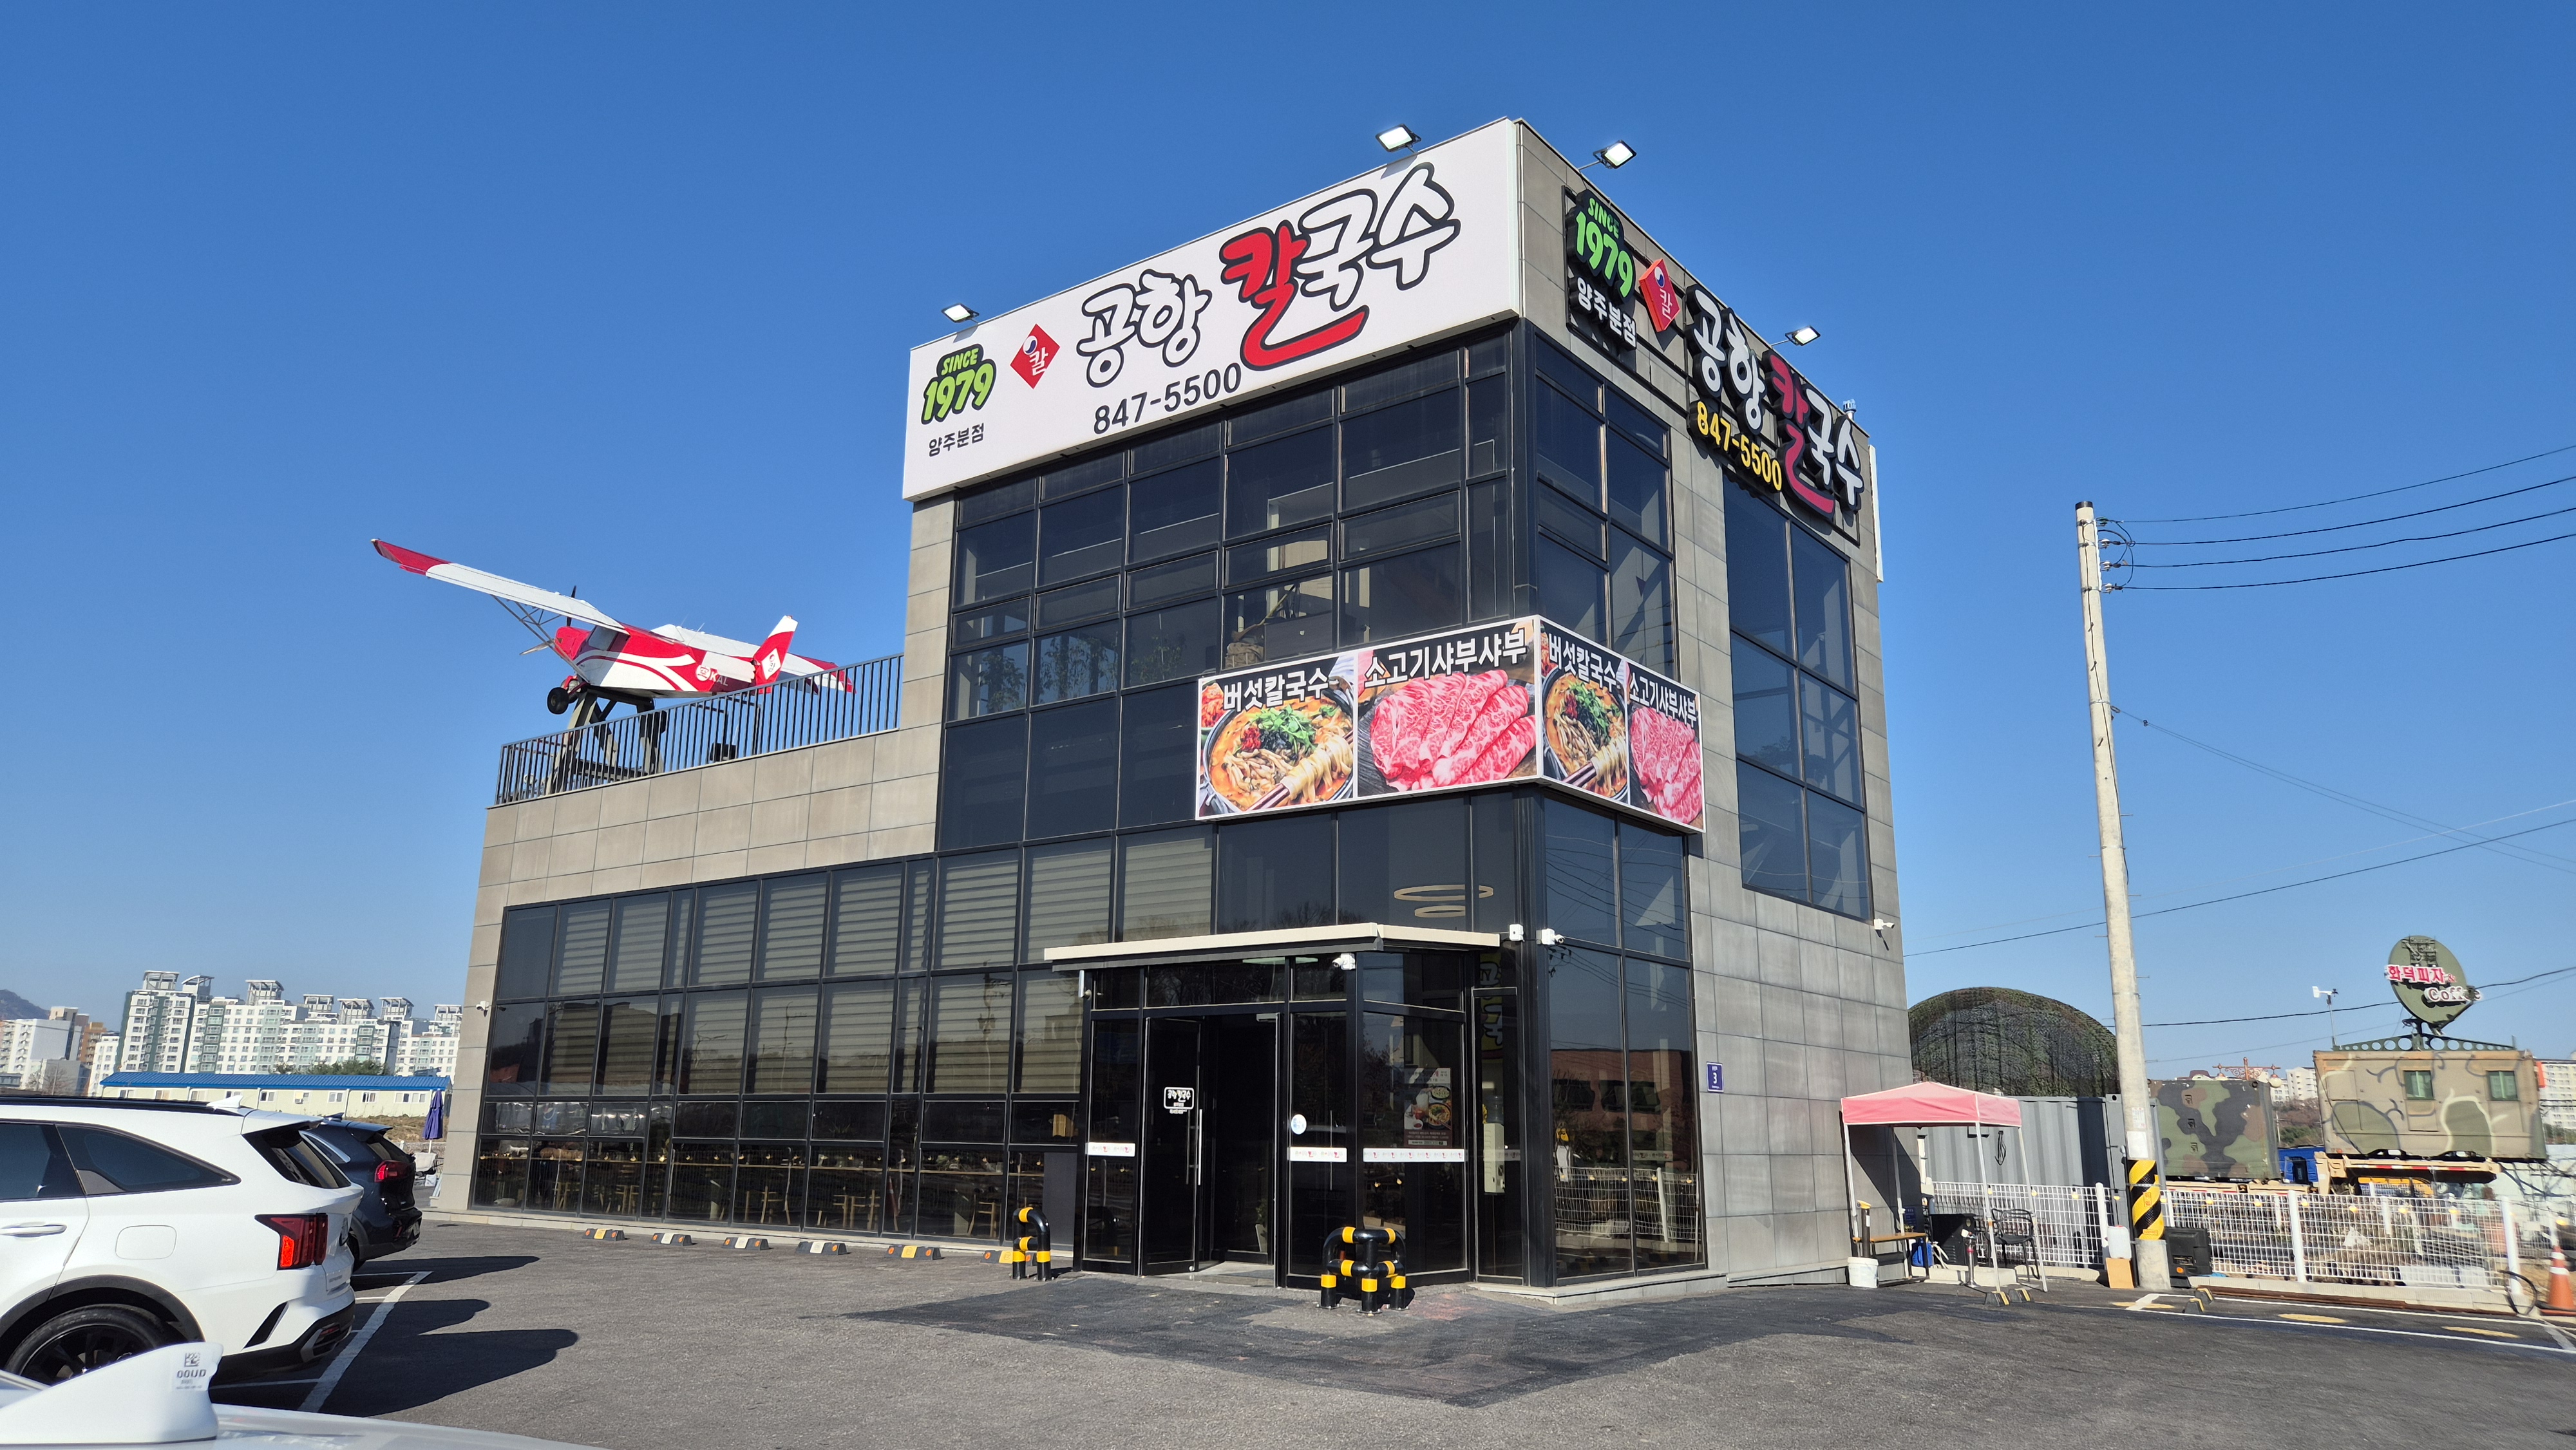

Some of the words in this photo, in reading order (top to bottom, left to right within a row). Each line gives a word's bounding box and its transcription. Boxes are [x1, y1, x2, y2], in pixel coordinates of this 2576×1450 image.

[1588, 198, 1620, 239] SINCE
[1077, 269, 1211, 388] 공항
[1220, 162, 1461, 371] 칼국수
[1576, 211, 1633, 298] 1979
[1577, 277, 1636, 348] 양주분점
[1660, 288, 1673, 320] 칼
[941, 348, 979, 375] SINCE
[1029, 346, 1048, 376] 칼
[923, 362, 994, 422] 1979
[1094, 362, 1242, 434] 847-5500
[1694, 288, 1765, 431] 공항
[1770, 354, 1862, 514] 칼국수
[928, 422, 985, 458] 양주분점
[1697, 401, 1783, 491] 847-5500
[710, 671, 728, 686] KAL
[1365, 626, 1527, 688] 소고기샤부샤부
[1548, 632, 1619, 692] 버섯칼국수
[1223, 673, 1330, 711] 버섯칼국수
[1629, 677, 1698, 729] 소고기샤부샤부
[2388, 966, 2445, 983] 화덕피자
[1712, 1072, 1718, 1084] 3
